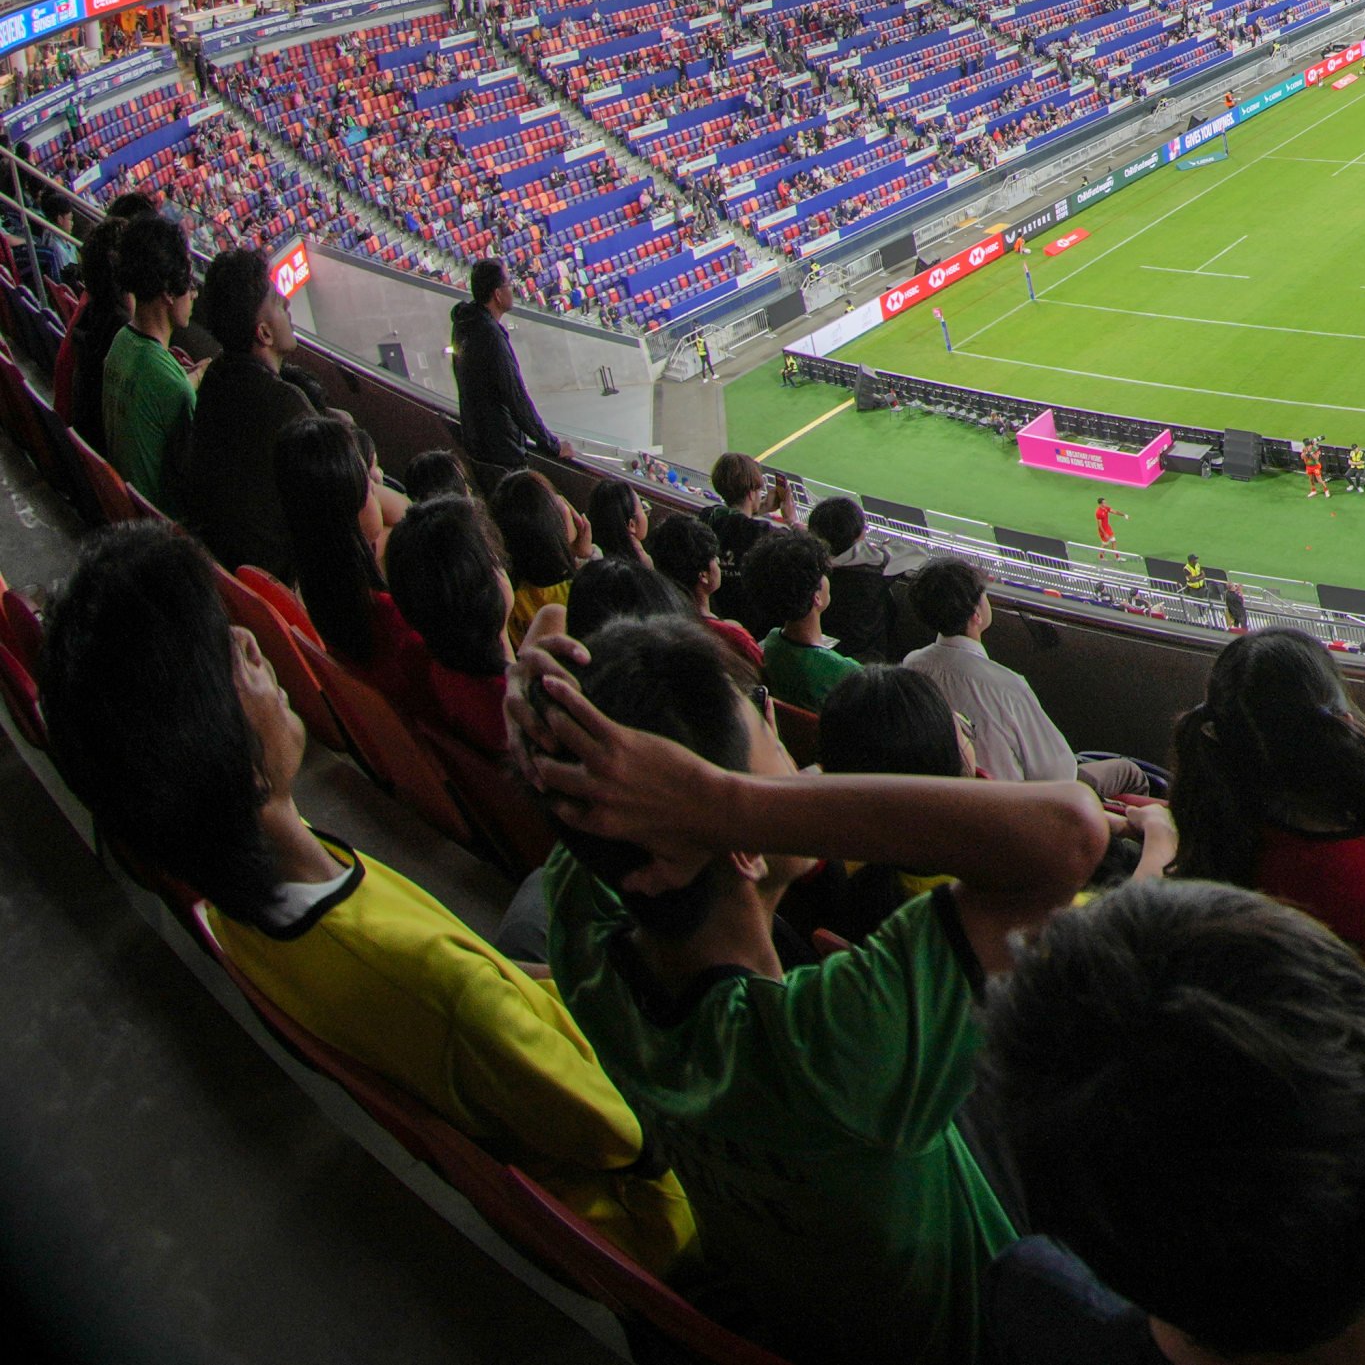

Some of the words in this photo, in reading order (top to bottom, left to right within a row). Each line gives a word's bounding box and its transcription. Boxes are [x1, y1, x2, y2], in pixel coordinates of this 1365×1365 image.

[1185, 129, 1201, 148] GIVES
[1200, 124, 1212, 140] YOU
[294, 262, 309, 284] HSBC
[904, 285, 919, 299] HSBC
[945, 263, 960, 276] HSBC
[985, 242, 999, 254] HSBC
[1056, 454, 1070, 464] HONG
[1071, 456, 1084, 467] KONG
[1085, 459, 1104, 470] SEVENS
